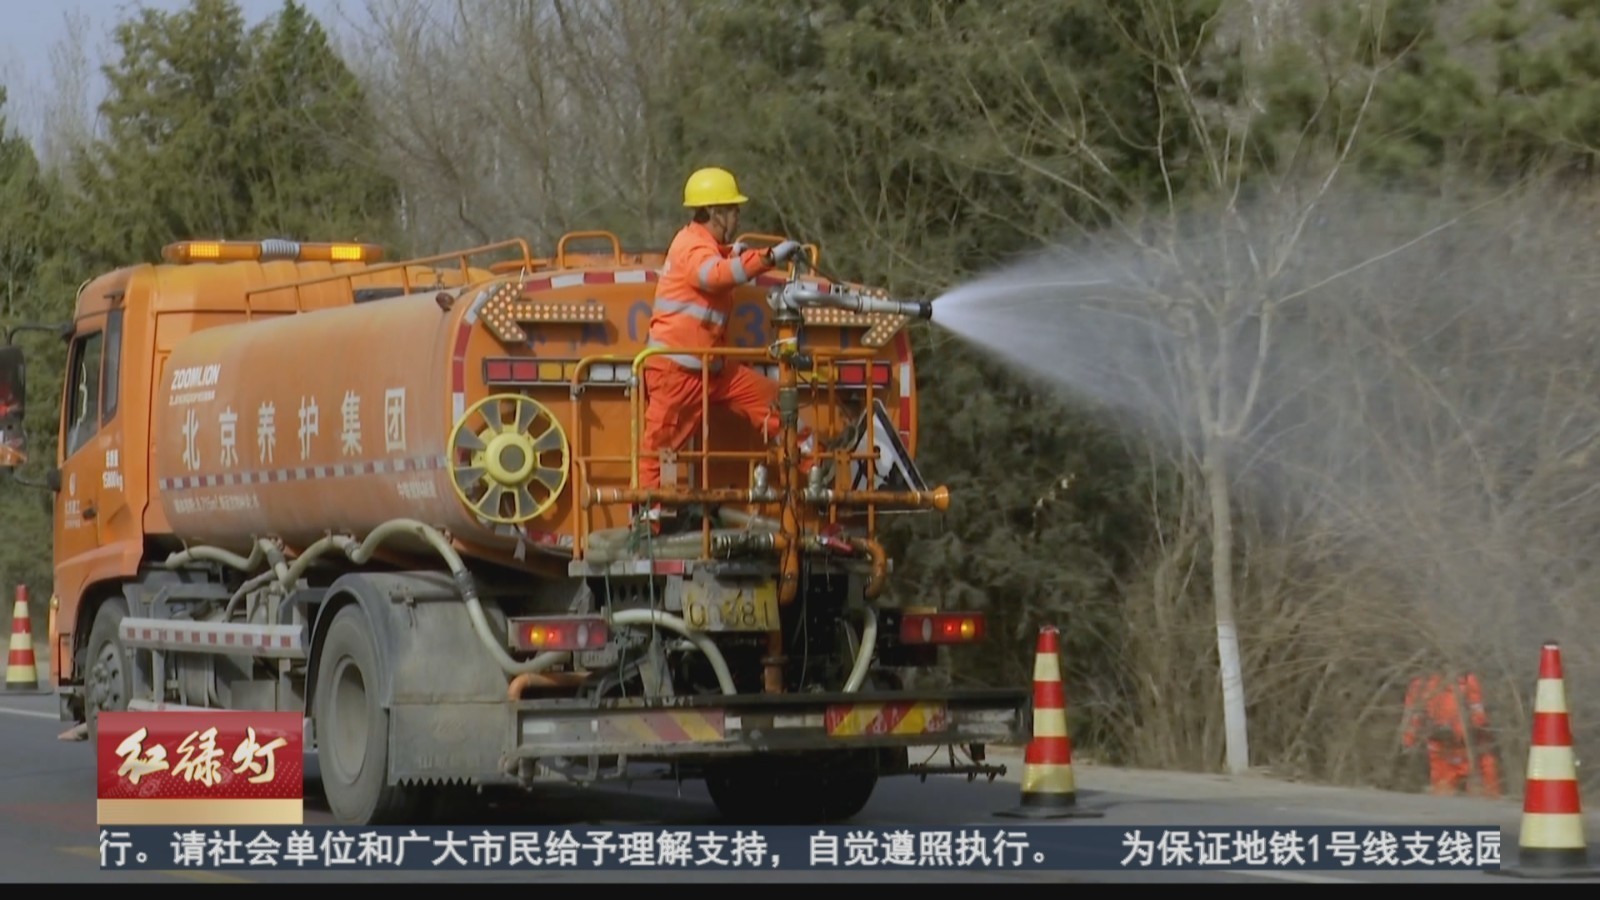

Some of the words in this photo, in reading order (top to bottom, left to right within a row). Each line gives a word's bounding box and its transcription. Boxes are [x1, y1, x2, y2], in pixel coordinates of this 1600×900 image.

[171, 363, 221, 391] ZOOMLION
[182, 387, 407, 471] 北京养护集团
